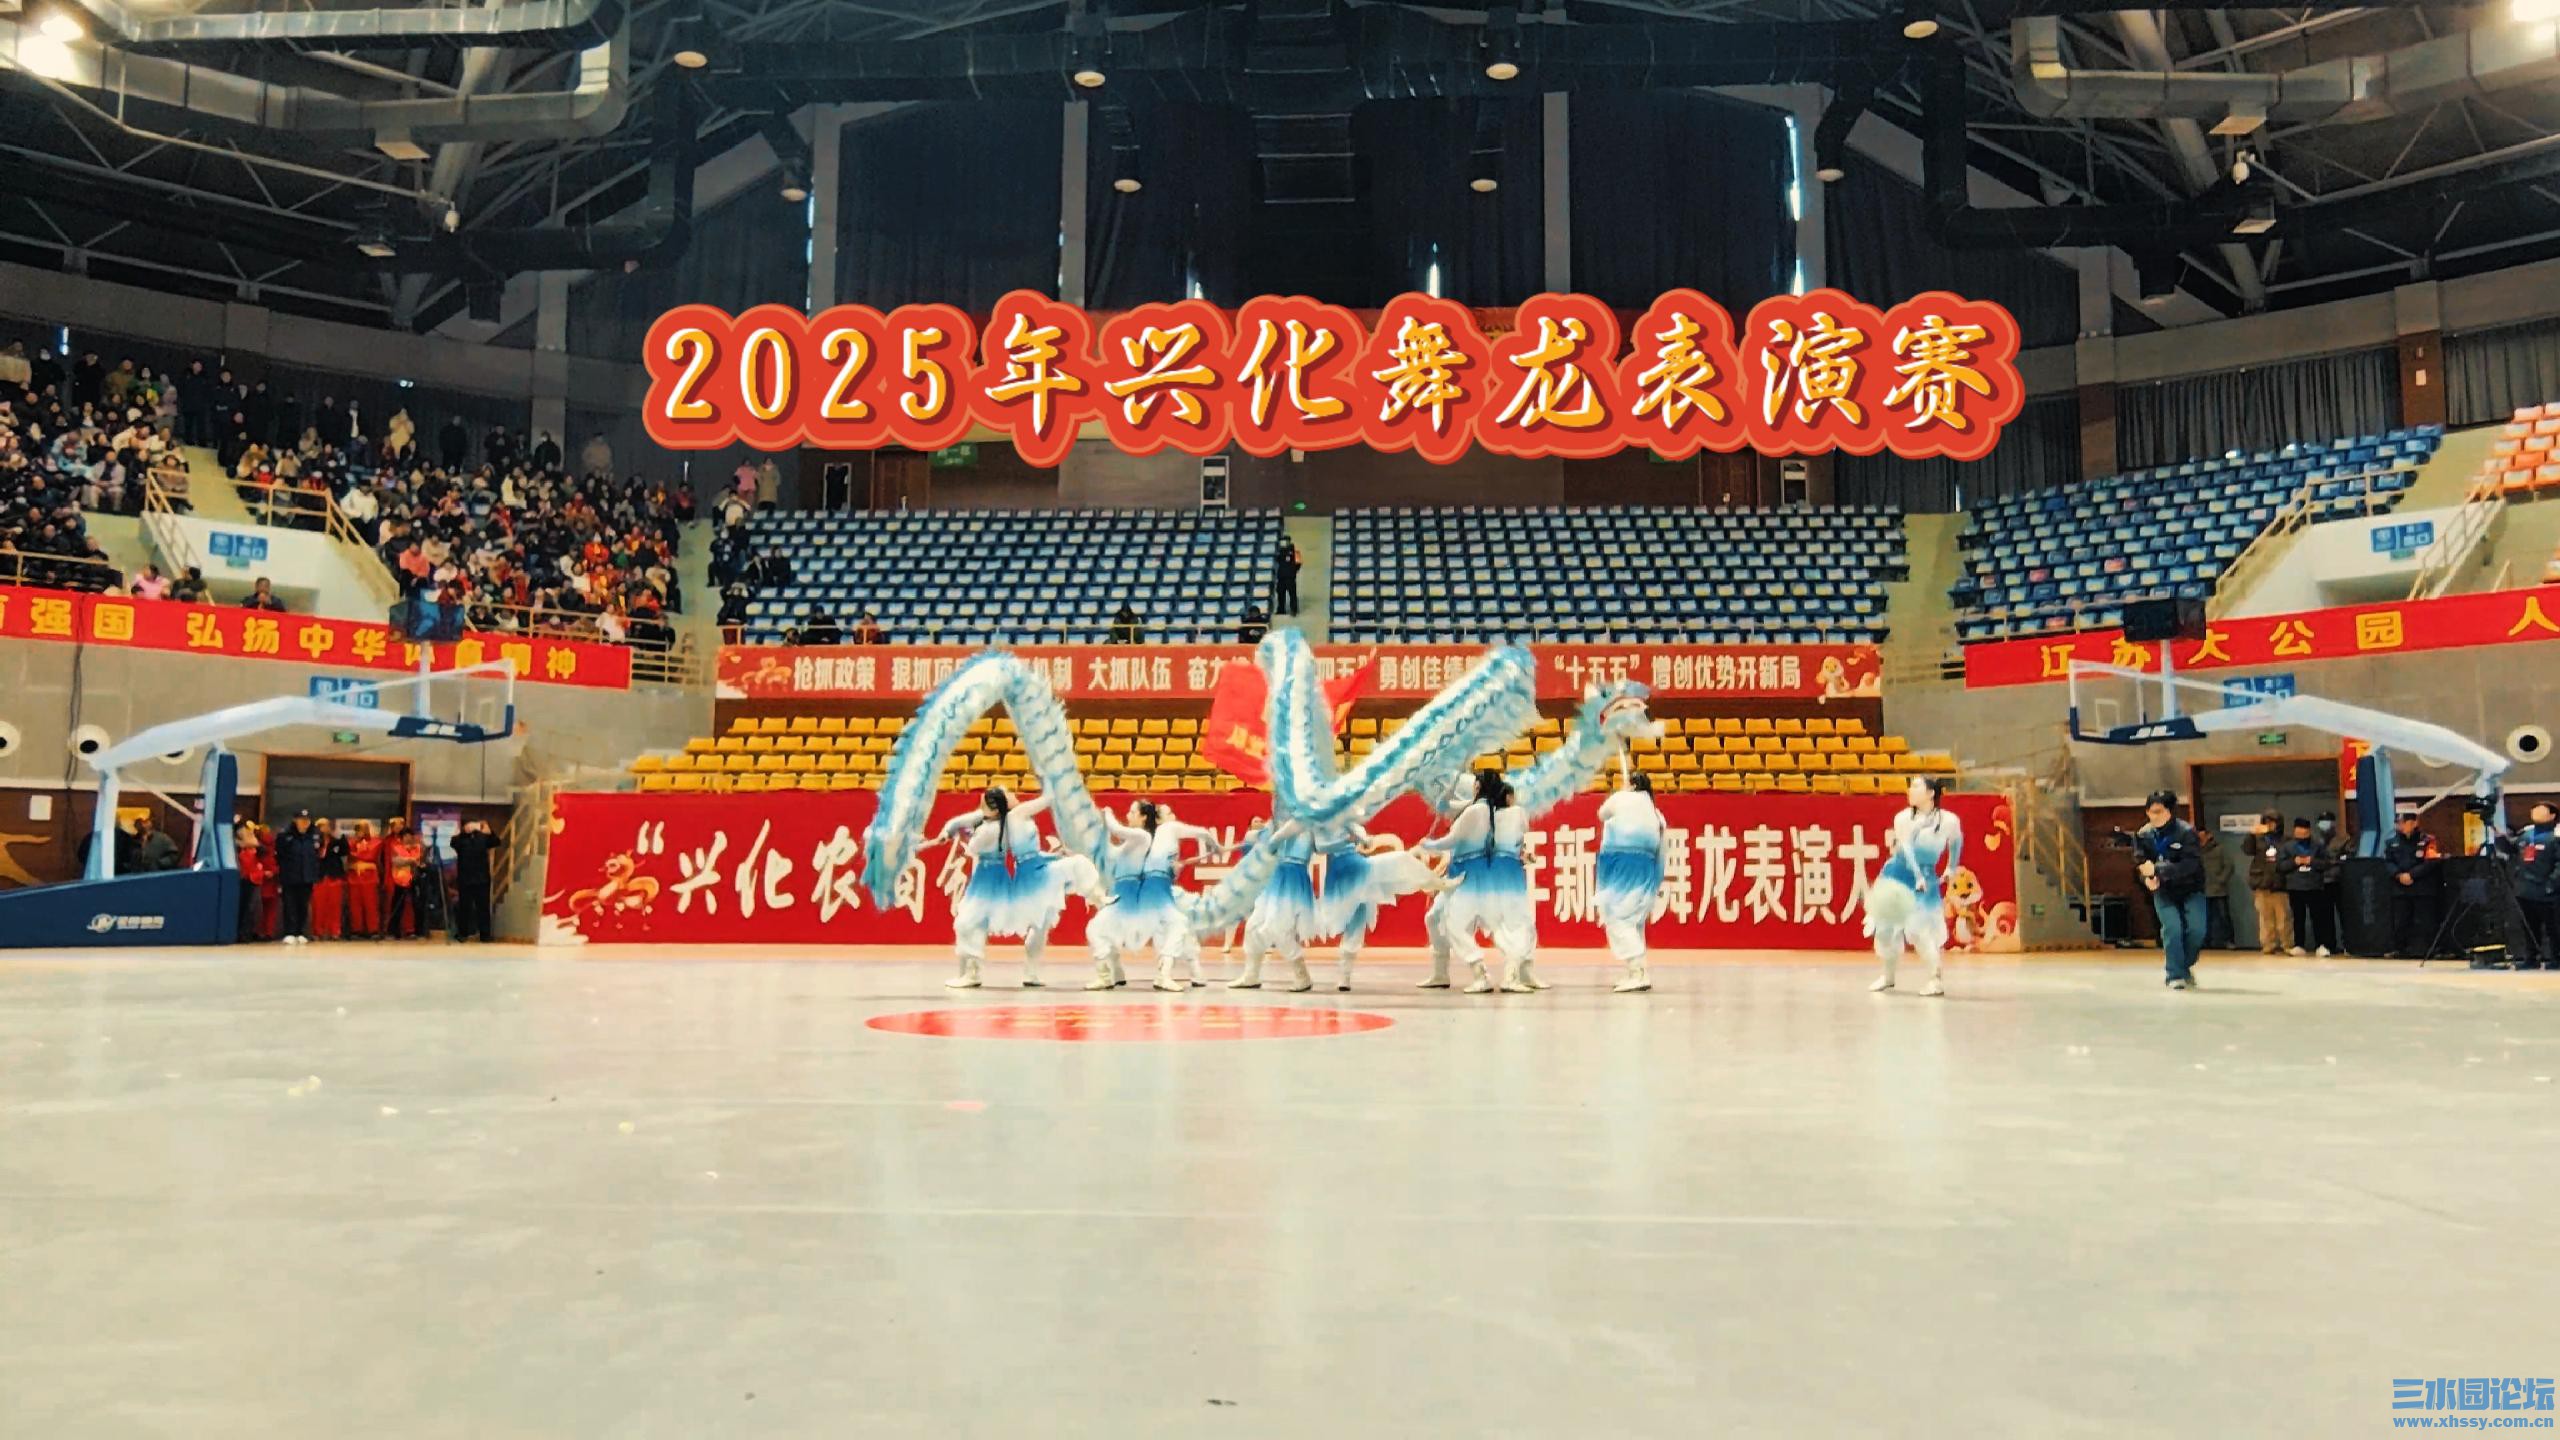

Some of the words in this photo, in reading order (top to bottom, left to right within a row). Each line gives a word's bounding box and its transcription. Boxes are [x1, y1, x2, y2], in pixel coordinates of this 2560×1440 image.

[0, 594, 135, 641] 强国
[793, 656, 876, 692] 抢抓政策
[891, 656, 968, 691] 狠抓项
[1088, 656, 1172, 692] 大抓队伍
